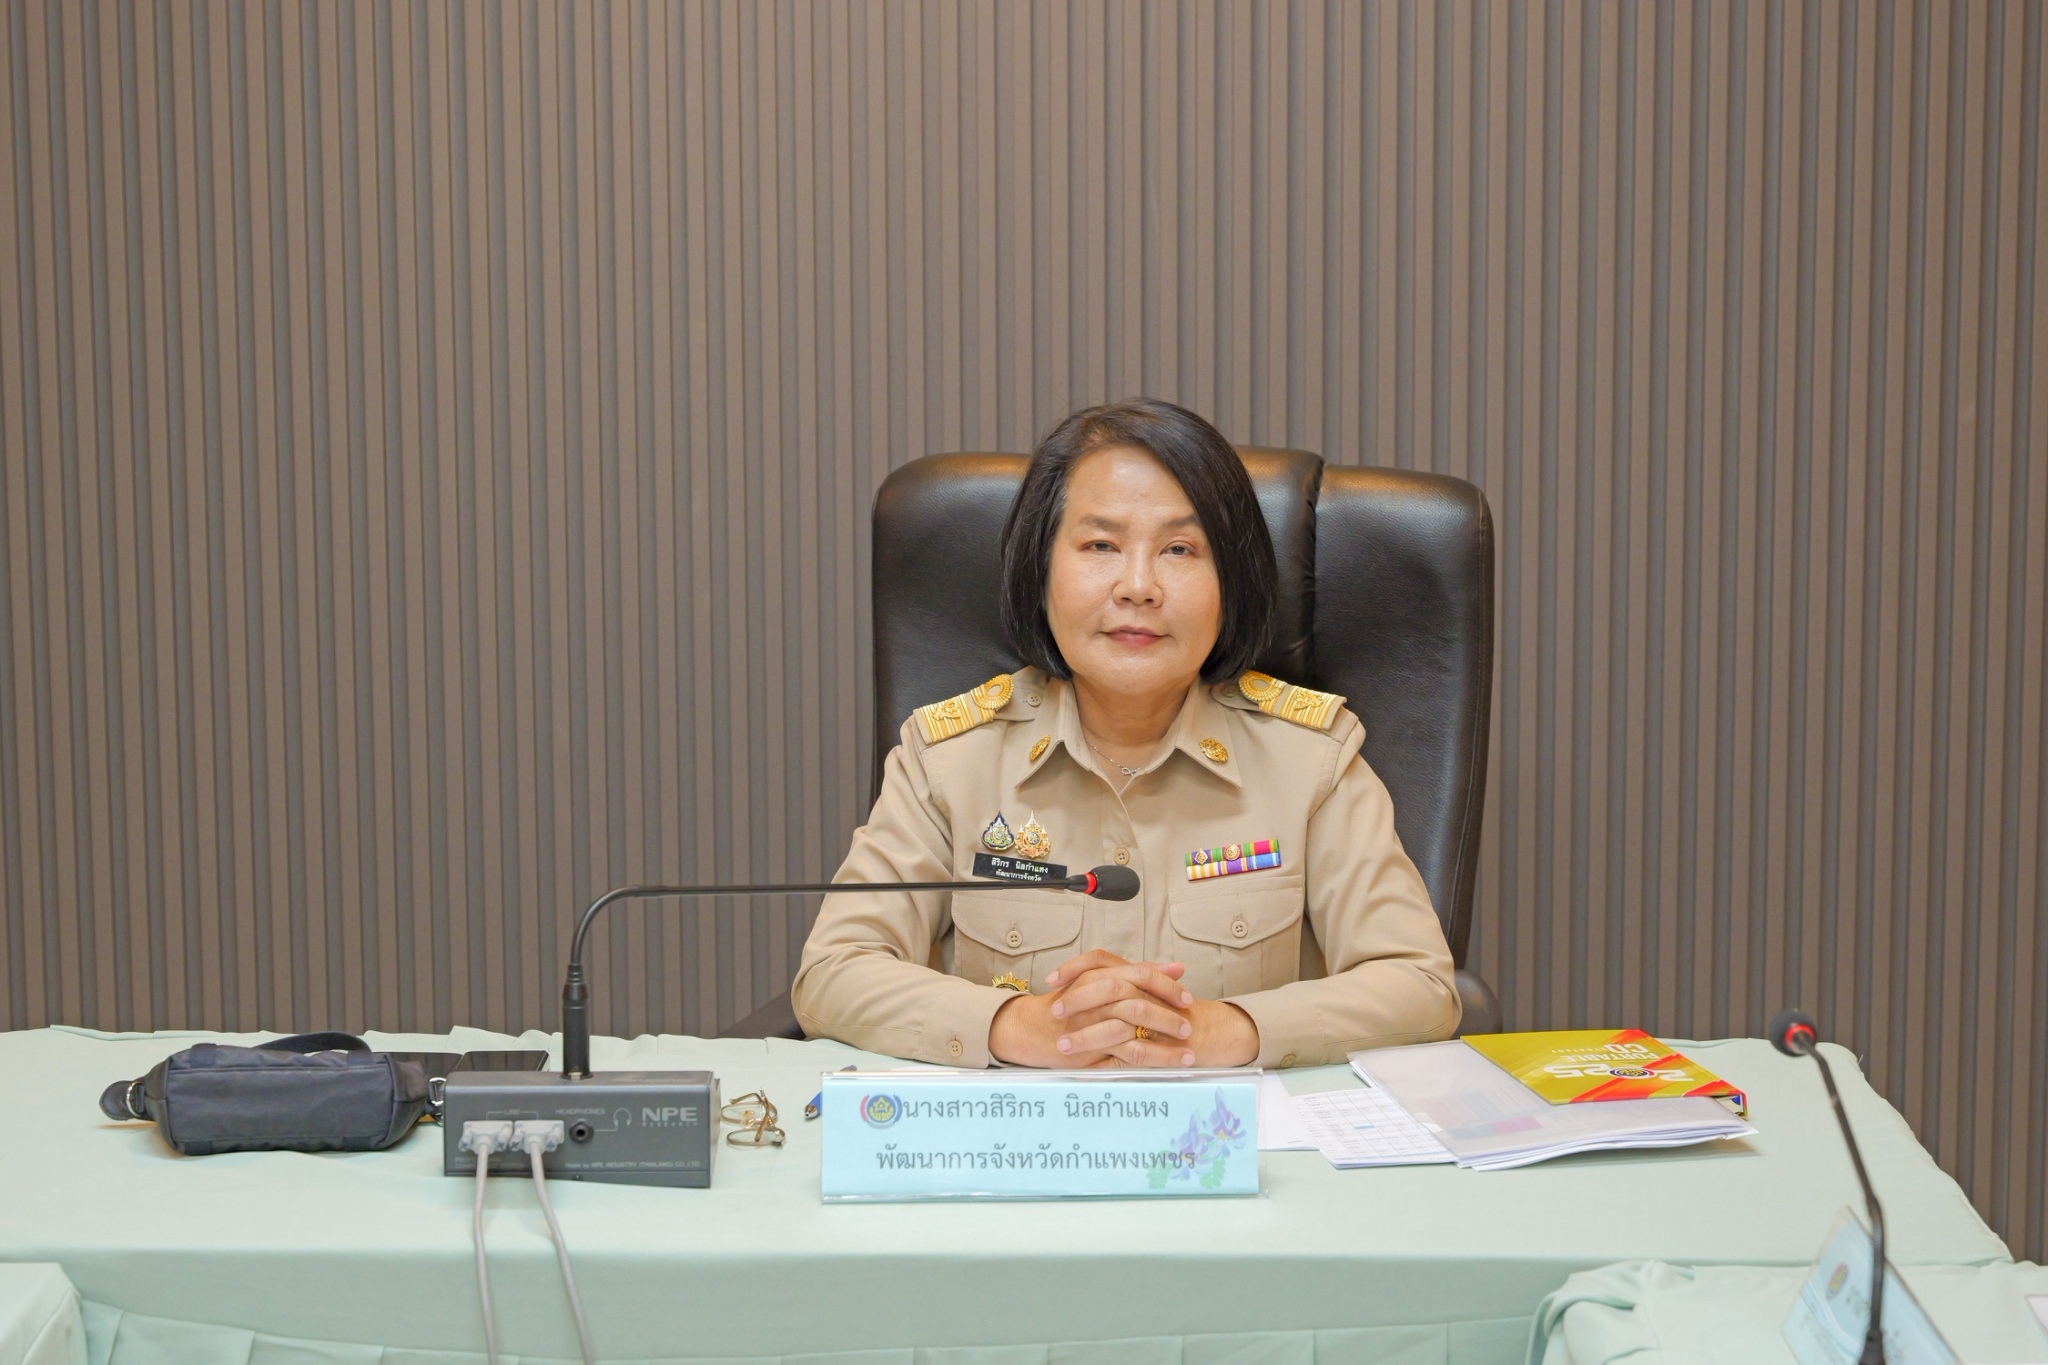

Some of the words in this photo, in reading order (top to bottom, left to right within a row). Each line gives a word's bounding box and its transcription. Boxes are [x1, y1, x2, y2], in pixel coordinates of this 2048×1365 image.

[991, 857, 1010, 868] สิริกร
[1560, 1052, 1660, 1062] PORTABLE
[555, 1107, 606, 1115] HEADPHONES
[902, 1093, 1045, 1119] นางสาวสิริกร
[1064, 1093, 1170, 1119] นิลกำแหง
[641, 1107, 698, 1122] NPE
[876, 1143, 1196, 1170] พัฒนาการจังหวัดกำแพงเพชร
